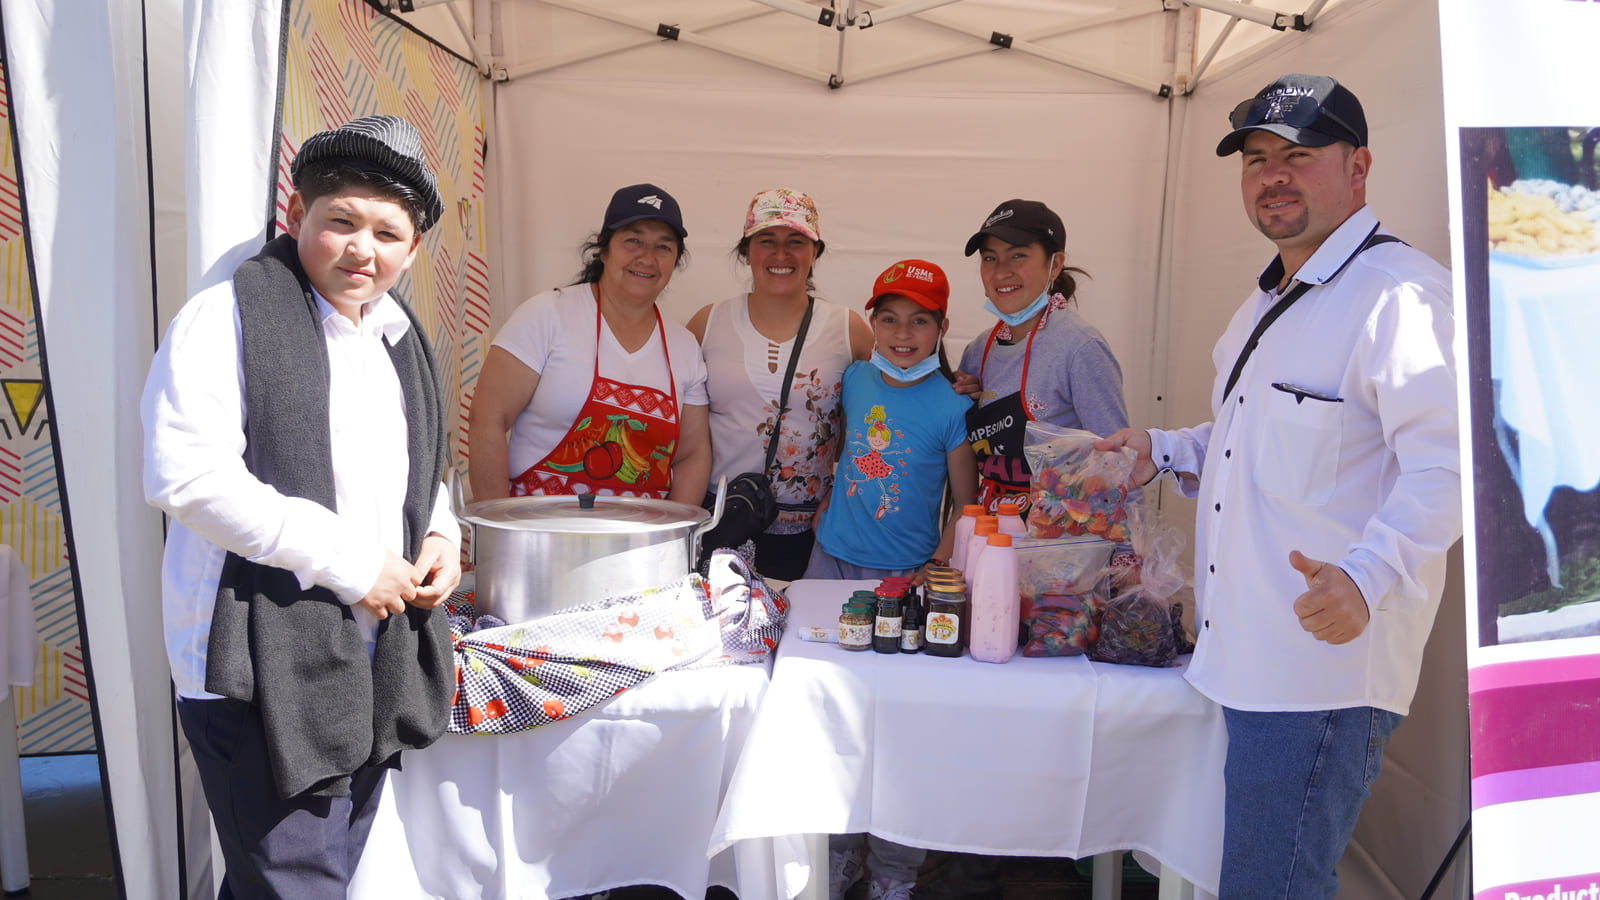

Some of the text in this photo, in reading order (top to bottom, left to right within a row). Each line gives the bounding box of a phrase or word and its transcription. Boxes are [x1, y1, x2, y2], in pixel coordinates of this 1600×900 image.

[907, 265, 934, 278] USME
[967, 415, 1014, 442] MPESINO
[978, 455, 1033, 482] AL
